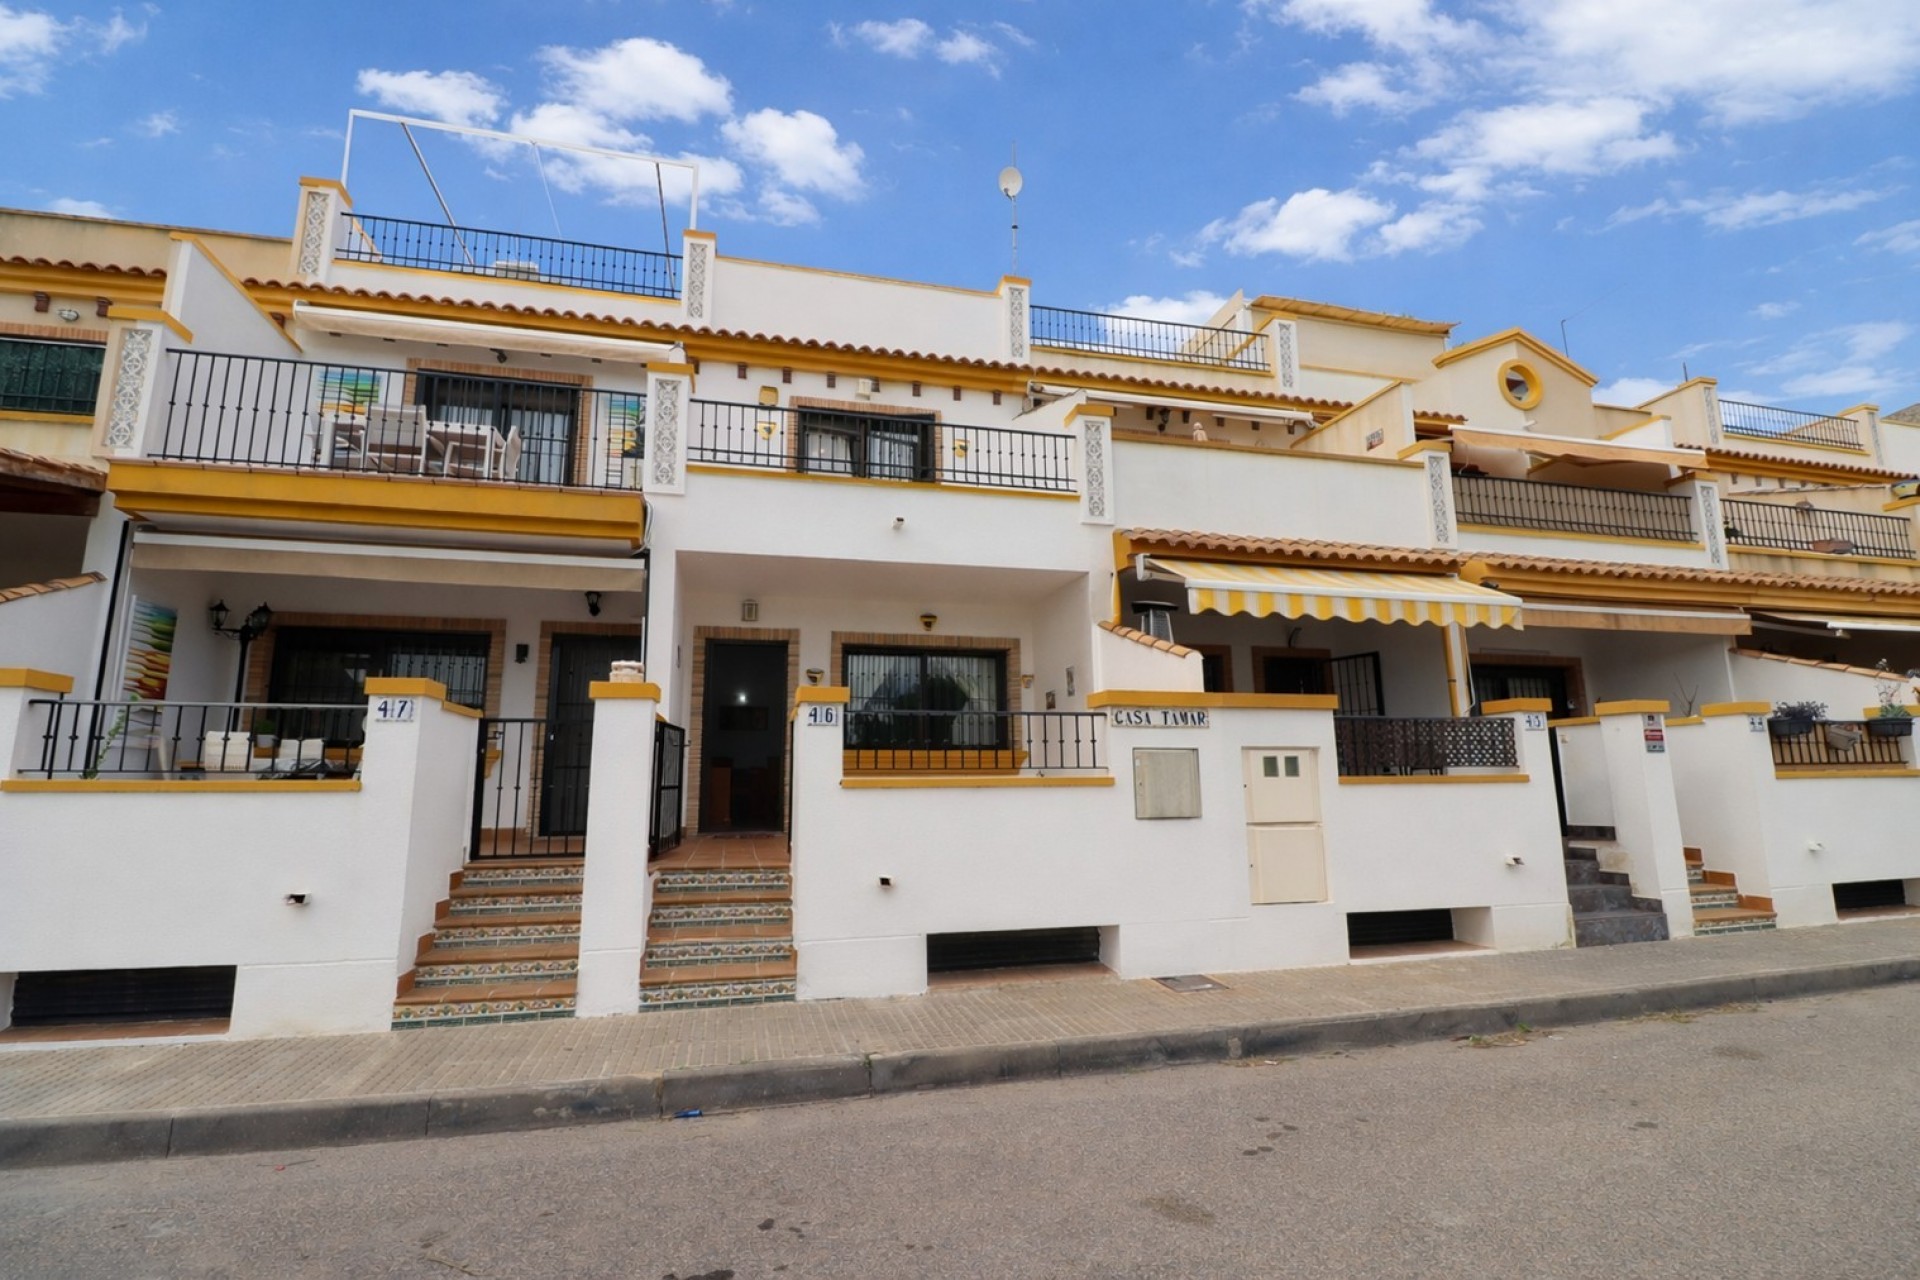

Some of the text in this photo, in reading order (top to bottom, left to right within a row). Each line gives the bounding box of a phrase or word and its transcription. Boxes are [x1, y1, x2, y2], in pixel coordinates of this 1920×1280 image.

[377, 700, 408, 718] 47
[808, 706, 833, 723] 46
[1114, 710, 1206, 726] CASA TAMAR
